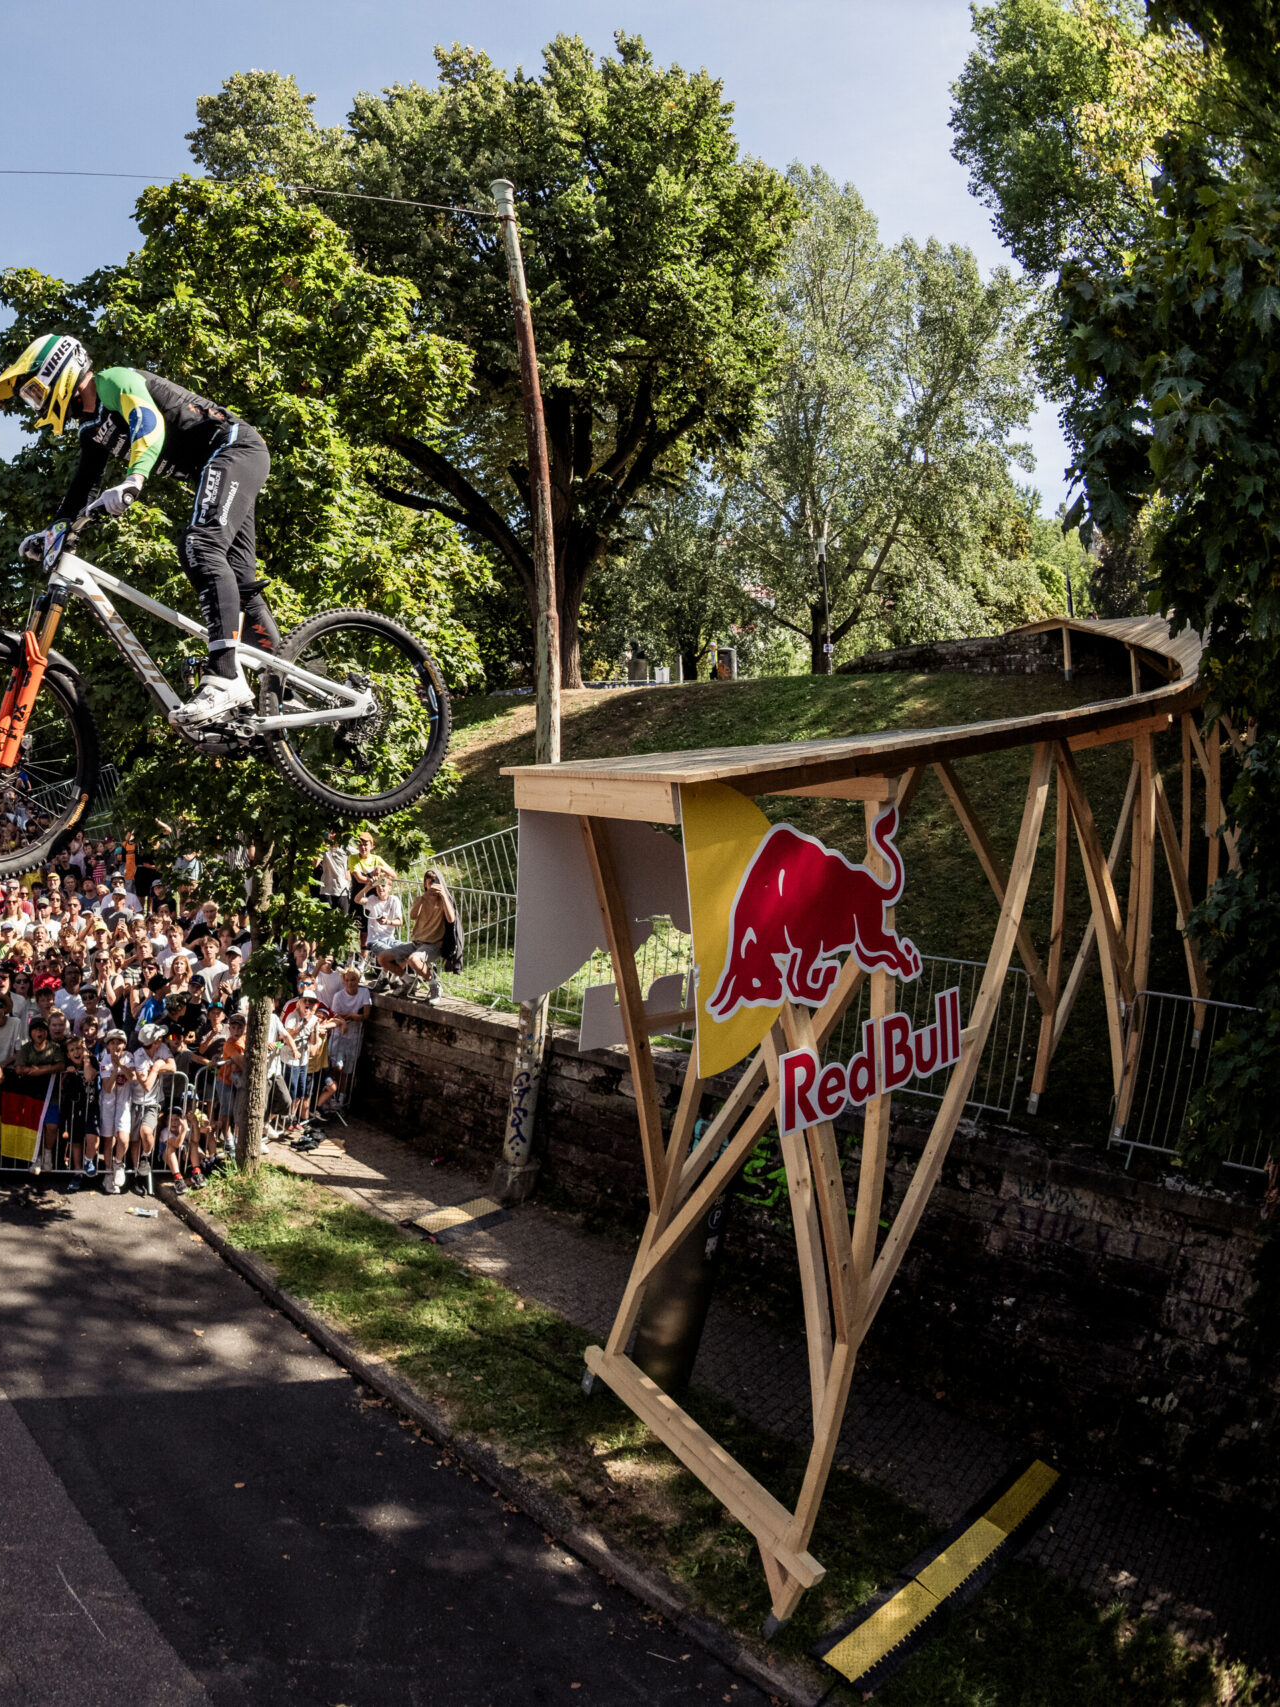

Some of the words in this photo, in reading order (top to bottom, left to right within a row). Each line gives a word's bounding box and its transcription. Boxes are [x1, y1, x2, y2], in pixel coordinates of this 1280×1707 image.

[40, 339, 72, 378] VIRIS
[780, 1020, 877, 1134] Red
[881, 988, 961, 1095] Bull
